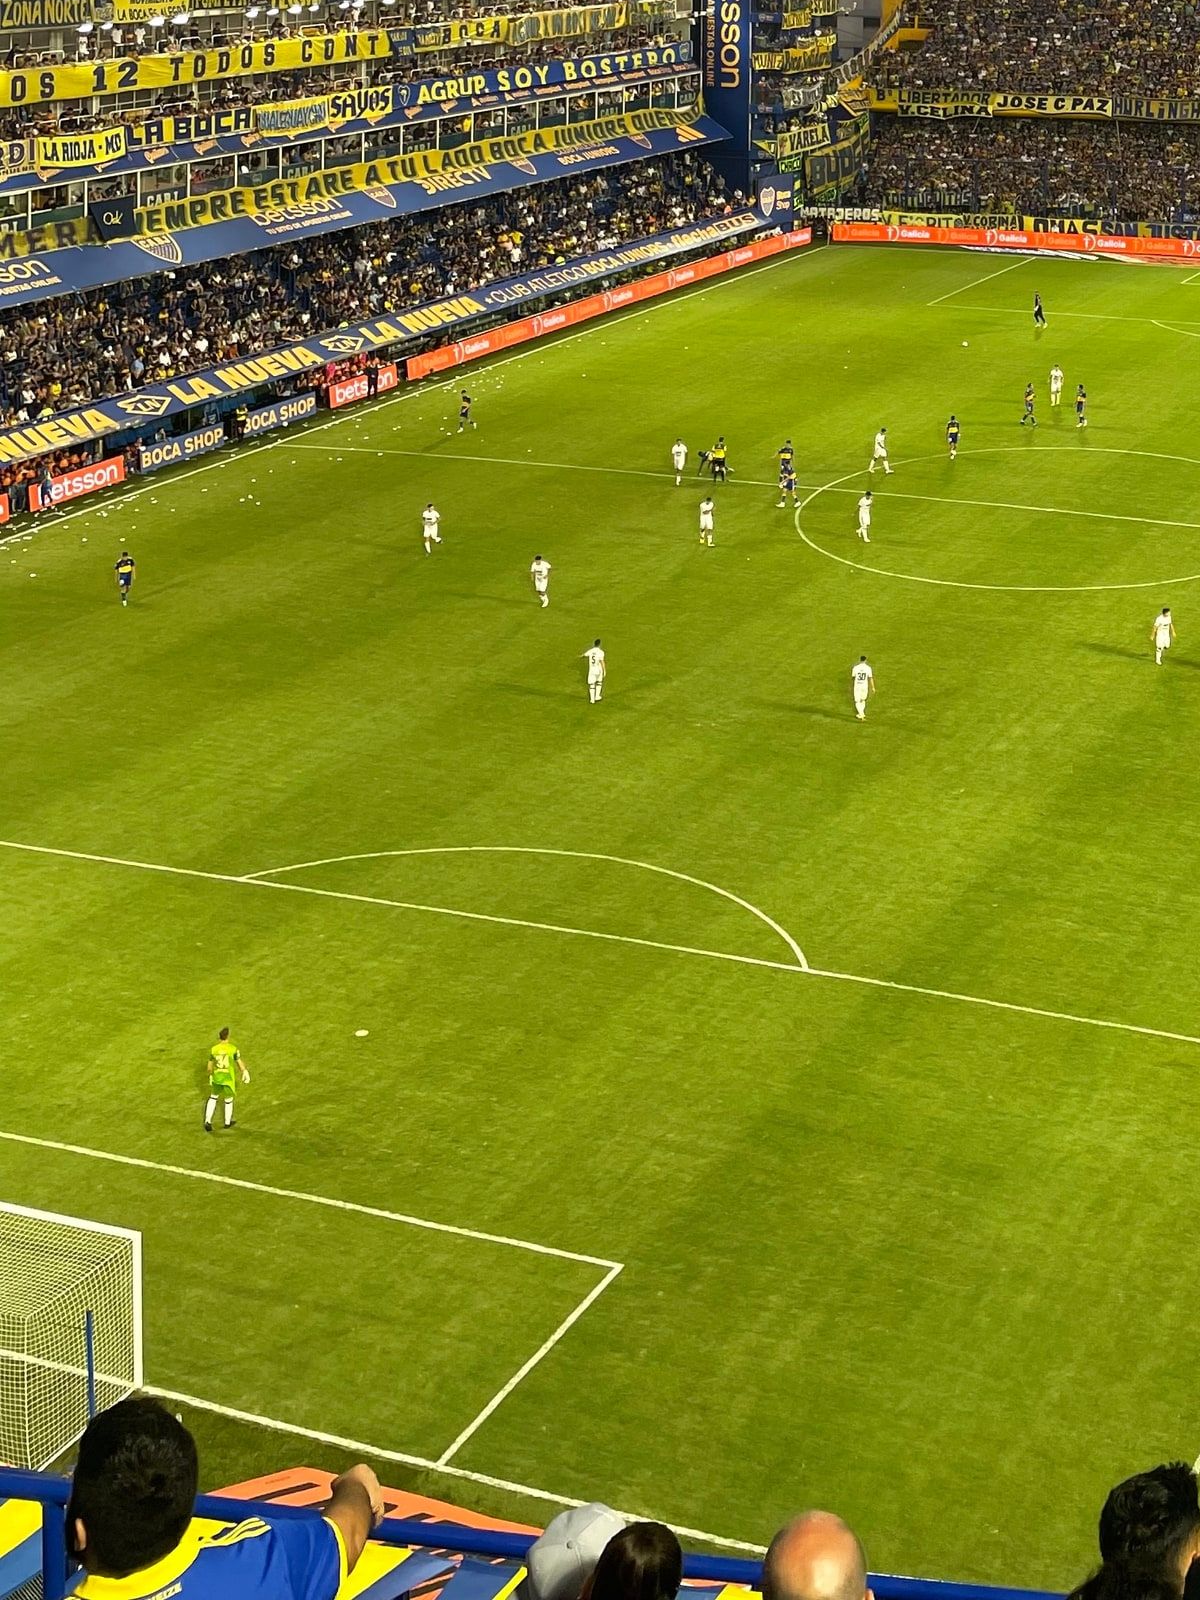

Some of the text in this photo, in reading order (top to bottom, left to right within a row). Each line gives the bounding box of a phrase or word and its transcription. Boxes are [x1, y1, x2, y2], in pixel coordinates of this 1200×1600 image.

[2, 0, 43, 28] ZONA
[92, 61, 138, 92] 12
[169, 43, 275, 81] TODOS
[497, 66, 548, 91] SOY
[562, 48, 676, 82] BOSTERO
[707, 50, 715, 87] ONLINE
[901, 91, 990, 104] LIBERTADOR
[997, 96, 1111, 112] JOSE C PAZ
[127, 107, 251, 146] LA BOCA
[44, 142, 60, 162] LA
[62, 139, 96, 161] RIOJA
[788, 131, 829, 150] VARELA
[557, 154, 585, 166] BOCA
[254, 169, 354, 209] ESTARE
[901, 227, 930, 238] Galicia
[999, 233, 1027, 243] Galicia
[1098, 239, 1126, 248] Galicia
[490, 283, 531, 304] CLUB
[586, 255, 621, 275] BOCA
[621, 241, 669, 265] JUNIORS
[359, 296, 486, 345] LA NUEVA
[543, 313, 566, 328] Galicia
[465, 340, 490, 355] Galicia
[167, 346, 325, 406] LA NUEVA
[280, 397, 316, 421] SHOP
[142, 427, 223, 468] BOCA SHOP
[857, 671, 867, 681] 30
